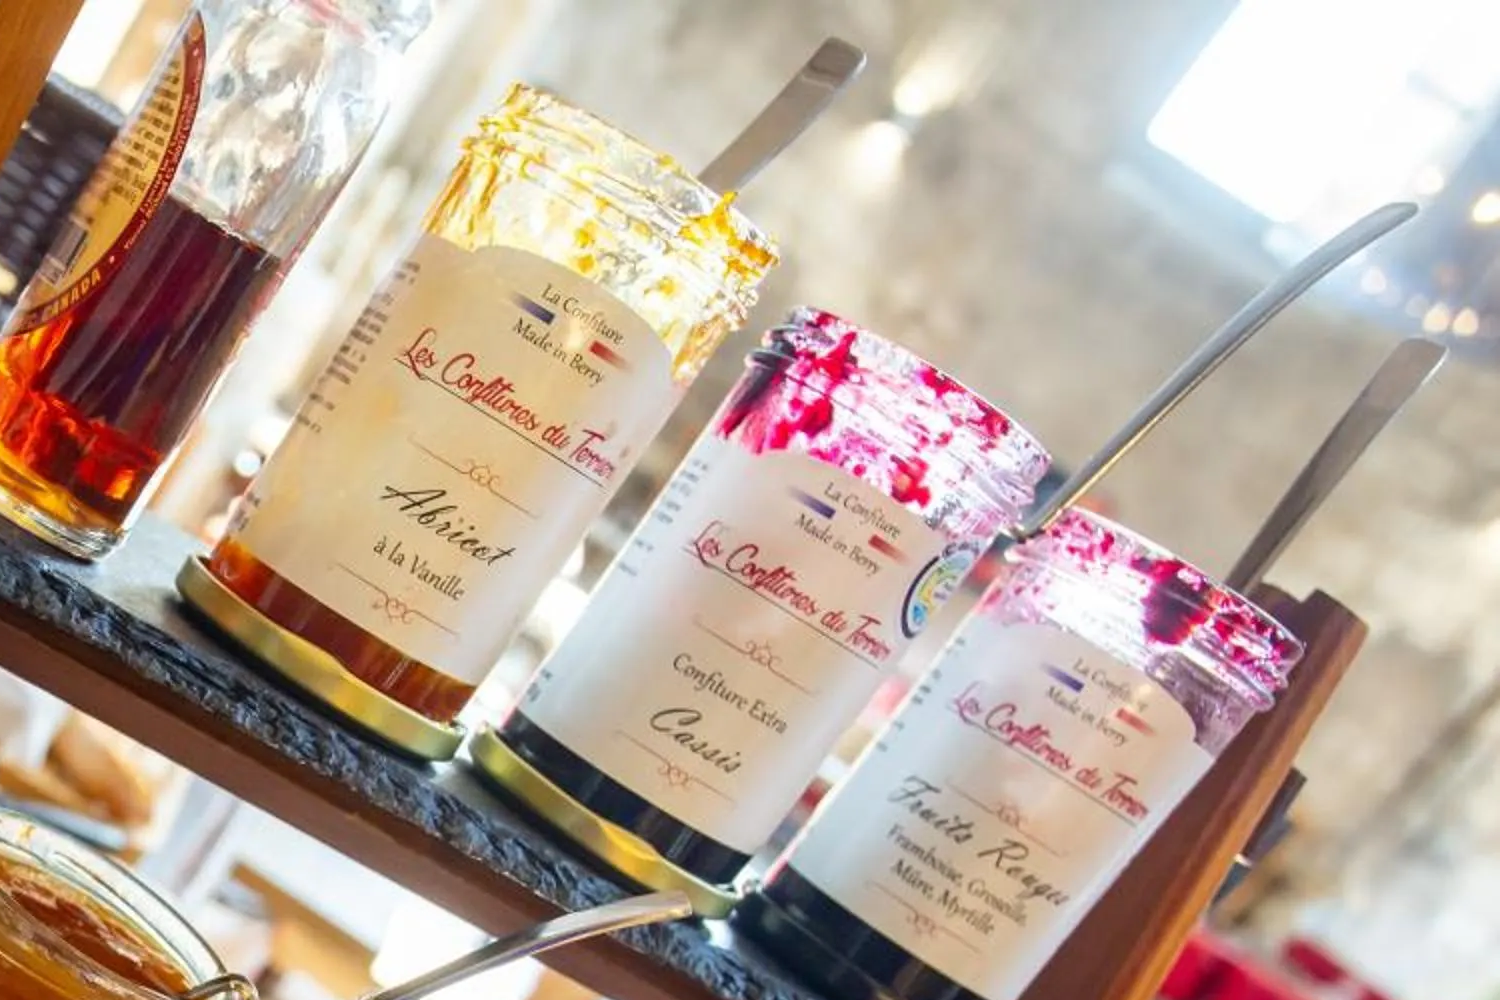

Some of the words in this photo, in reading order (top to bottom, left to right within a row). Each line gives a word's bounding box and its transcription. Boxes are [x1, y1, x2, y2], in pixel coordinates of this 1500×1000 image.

[541, 283, 563, 306] La
[563, 296, 625, 346] Confiture
[512, 317, 553, 353] Made
[552, 342, 568, 362] in
[568, 352, 605, 388] Berry
[403, 327, 437, 380] Les
[441, 353, 539, 430] Confitures
[541, 422, 570, 450] du
[380, 484, 517, 567] Abricot
[823, 481, 842, 503] La
[842, 496, 902, 540] Confiture
[372, 535, 388, 557] à
[388, 541, 405, 568] la
[409, 555, 467, 602] Vanille
[687, 520, 722, 567] Les
[725, 543, 821, 617] Confitures
[820, 608, 848, 634] du
[795, 513, 834, 545] Made
[832, 534, 848, 554] in
[848, 542, 881, 577] Berry
[672, 652, 750, 712] Confiture
[747, 698, 789, 735] Extra
[1046, 686, 1083, 717] Made
[1072, 658, 1092, 679] La
[650, 707, 743, 775] Cassis
[1075, 766, 1103, 791] du
[888, 775, 975, 845] Fruits
[977, 839, 1071, 907] Rouges
[938, 890, 996, 936] Myrtille
